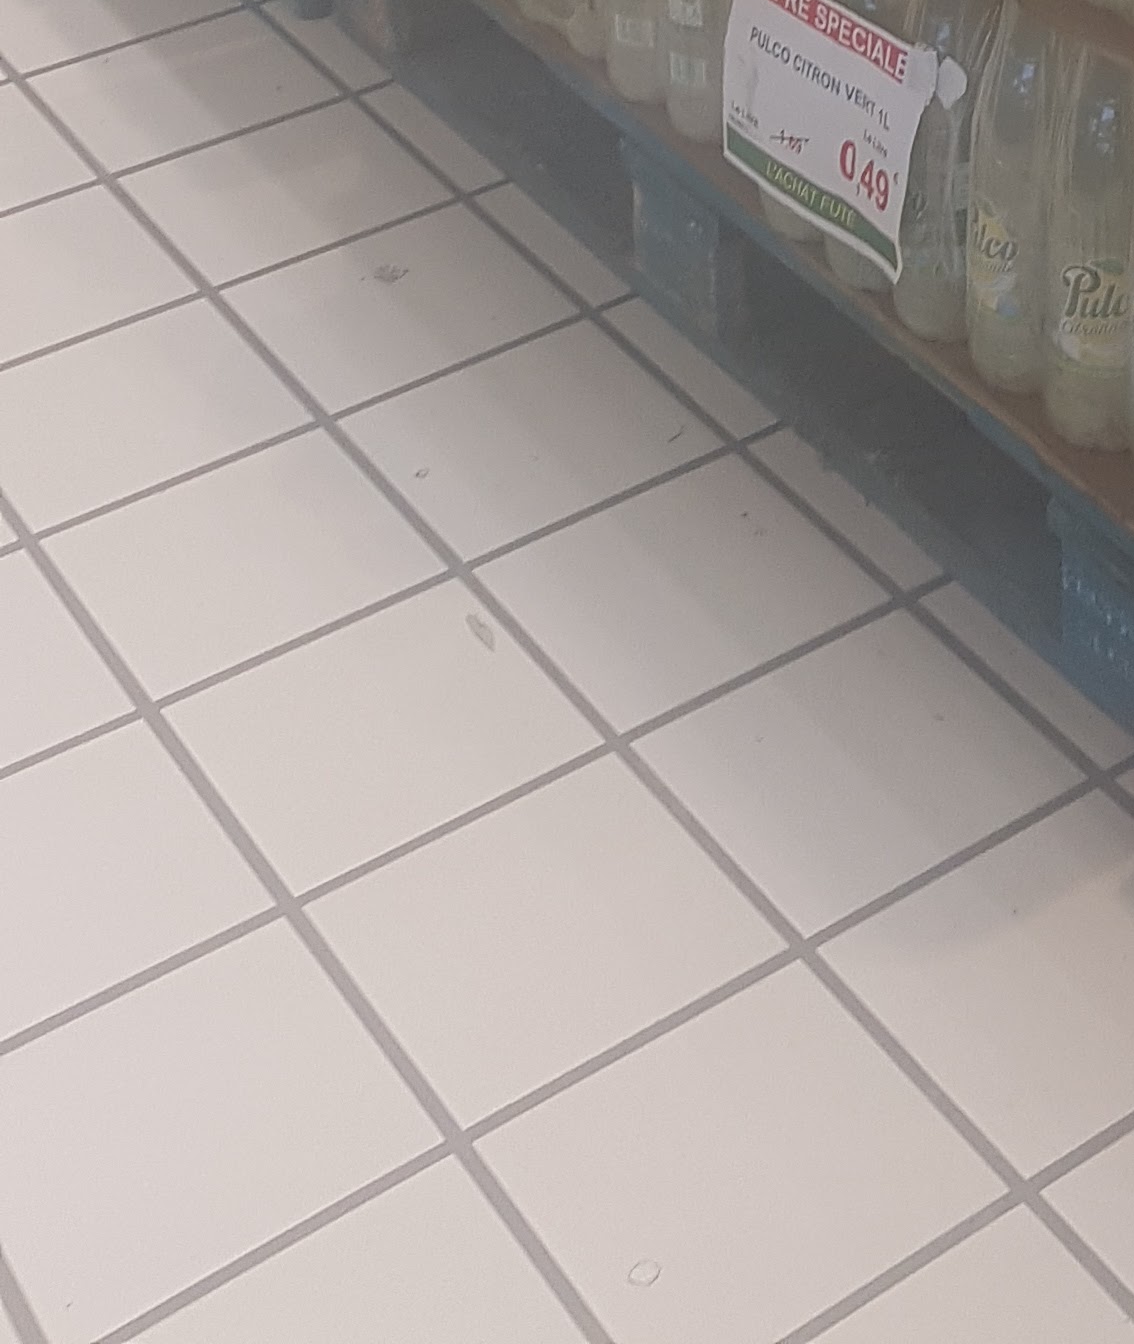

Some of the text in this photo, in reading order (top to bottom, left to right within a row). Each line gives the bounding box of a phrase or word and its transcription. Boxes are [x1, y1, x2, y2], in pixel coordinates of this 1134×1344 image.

[750, 26, 791, 65] PULCO
[793, 54, 842, 96] CITRON
[814, 2, 908, 82] SPECIALE
